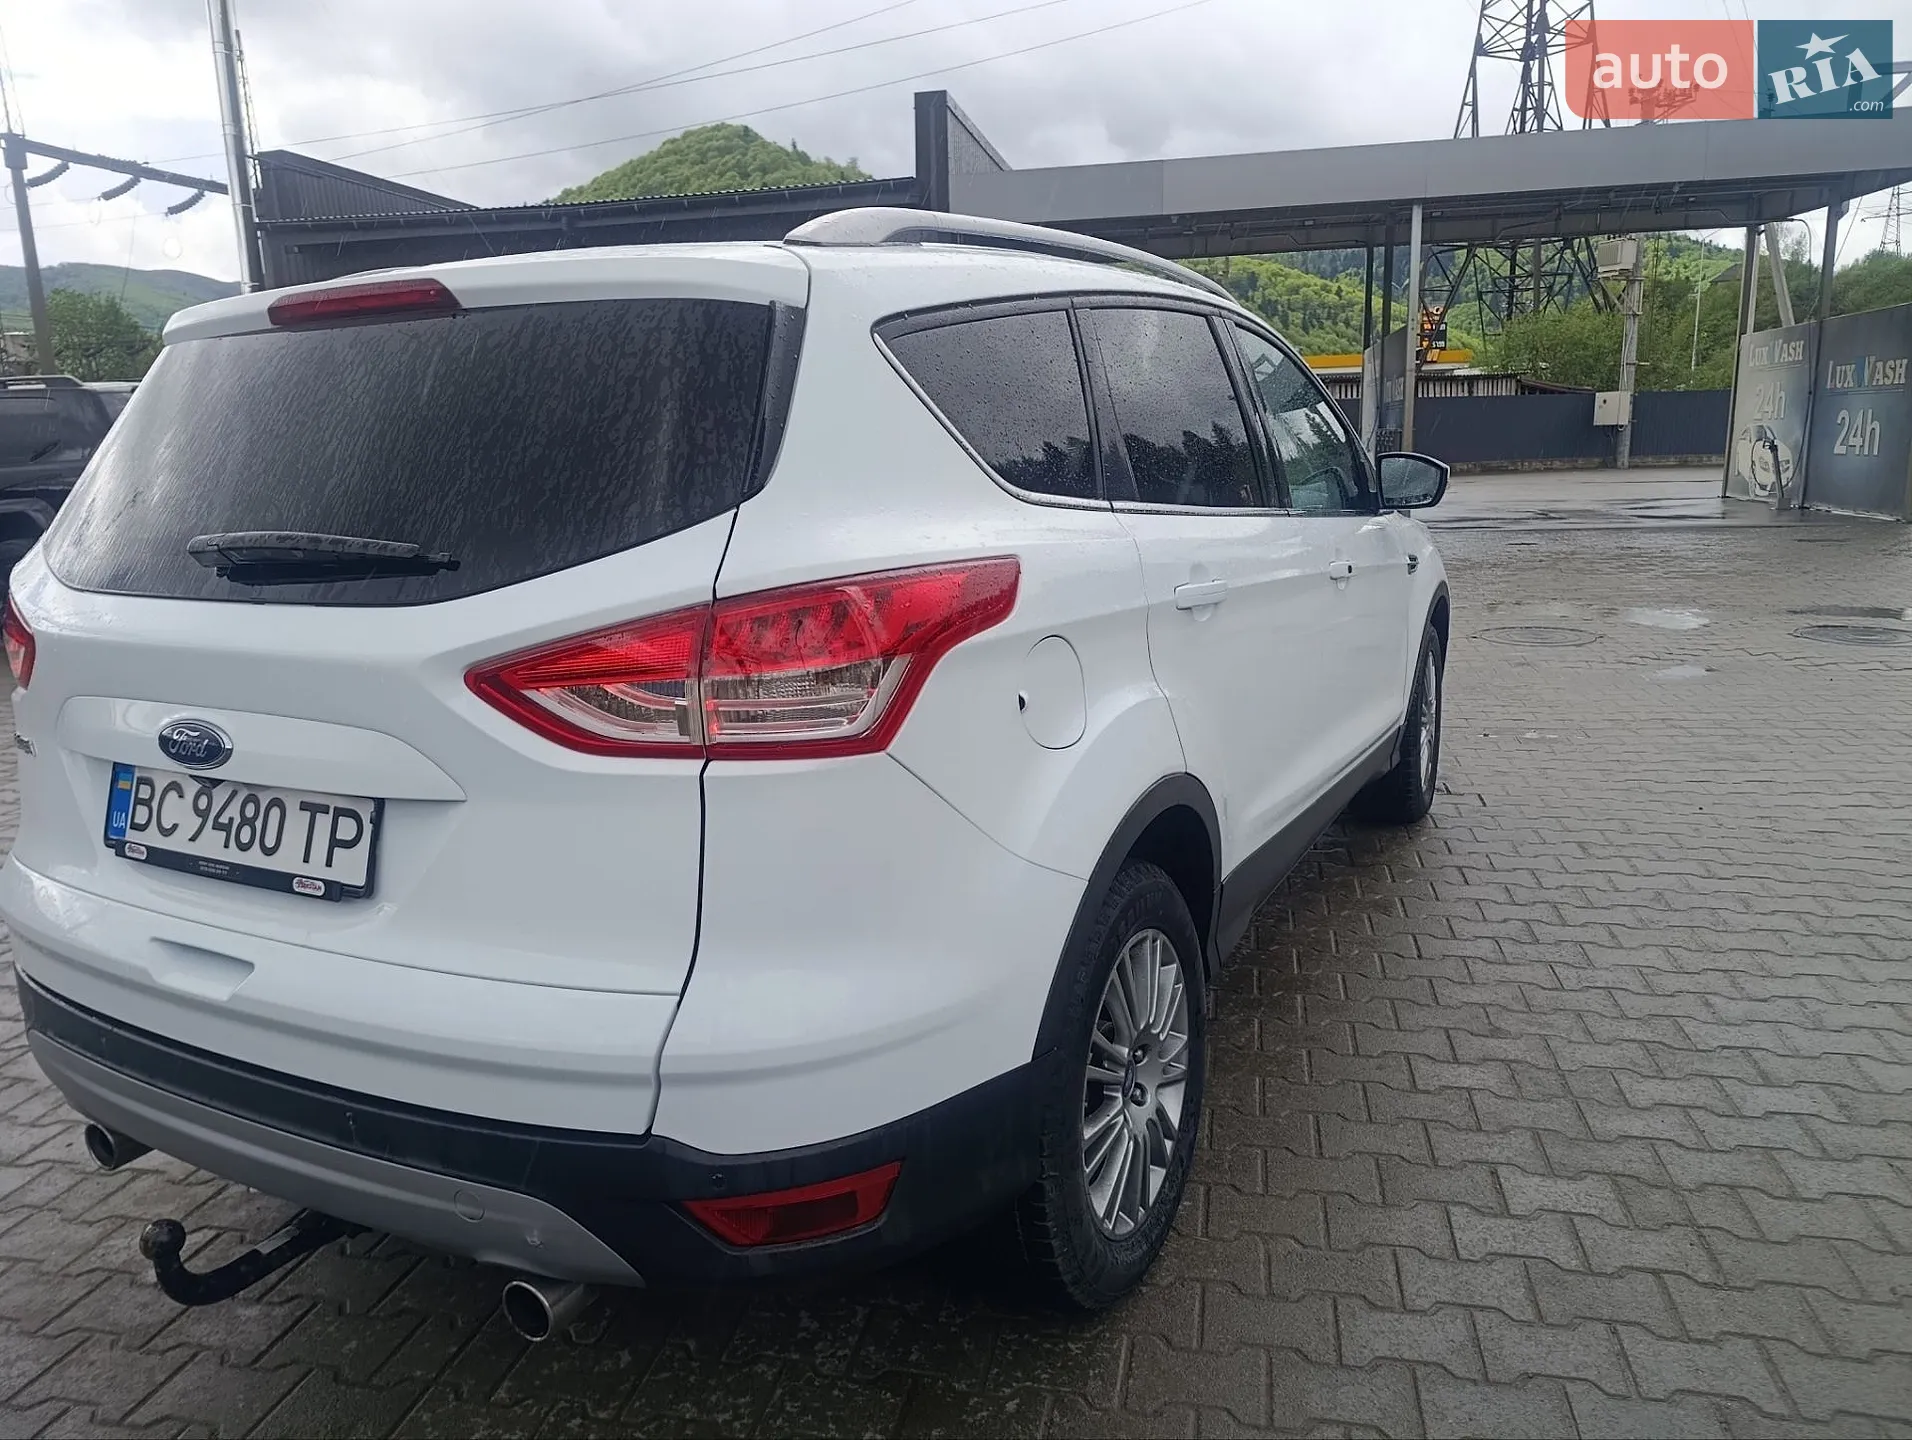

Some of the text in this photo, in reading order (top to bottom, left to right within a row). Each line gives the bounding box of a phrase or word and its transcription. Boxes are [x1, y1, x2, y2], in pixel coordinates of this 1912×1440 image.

[1753, 381, 1786, 421] 24h
[1833, 408, 1881, 456] 24h
[168, 728, 209, 758] Ford
[112, 811, 126, 829] UA
[129, 775, 364, 868] BC 9480 TP
